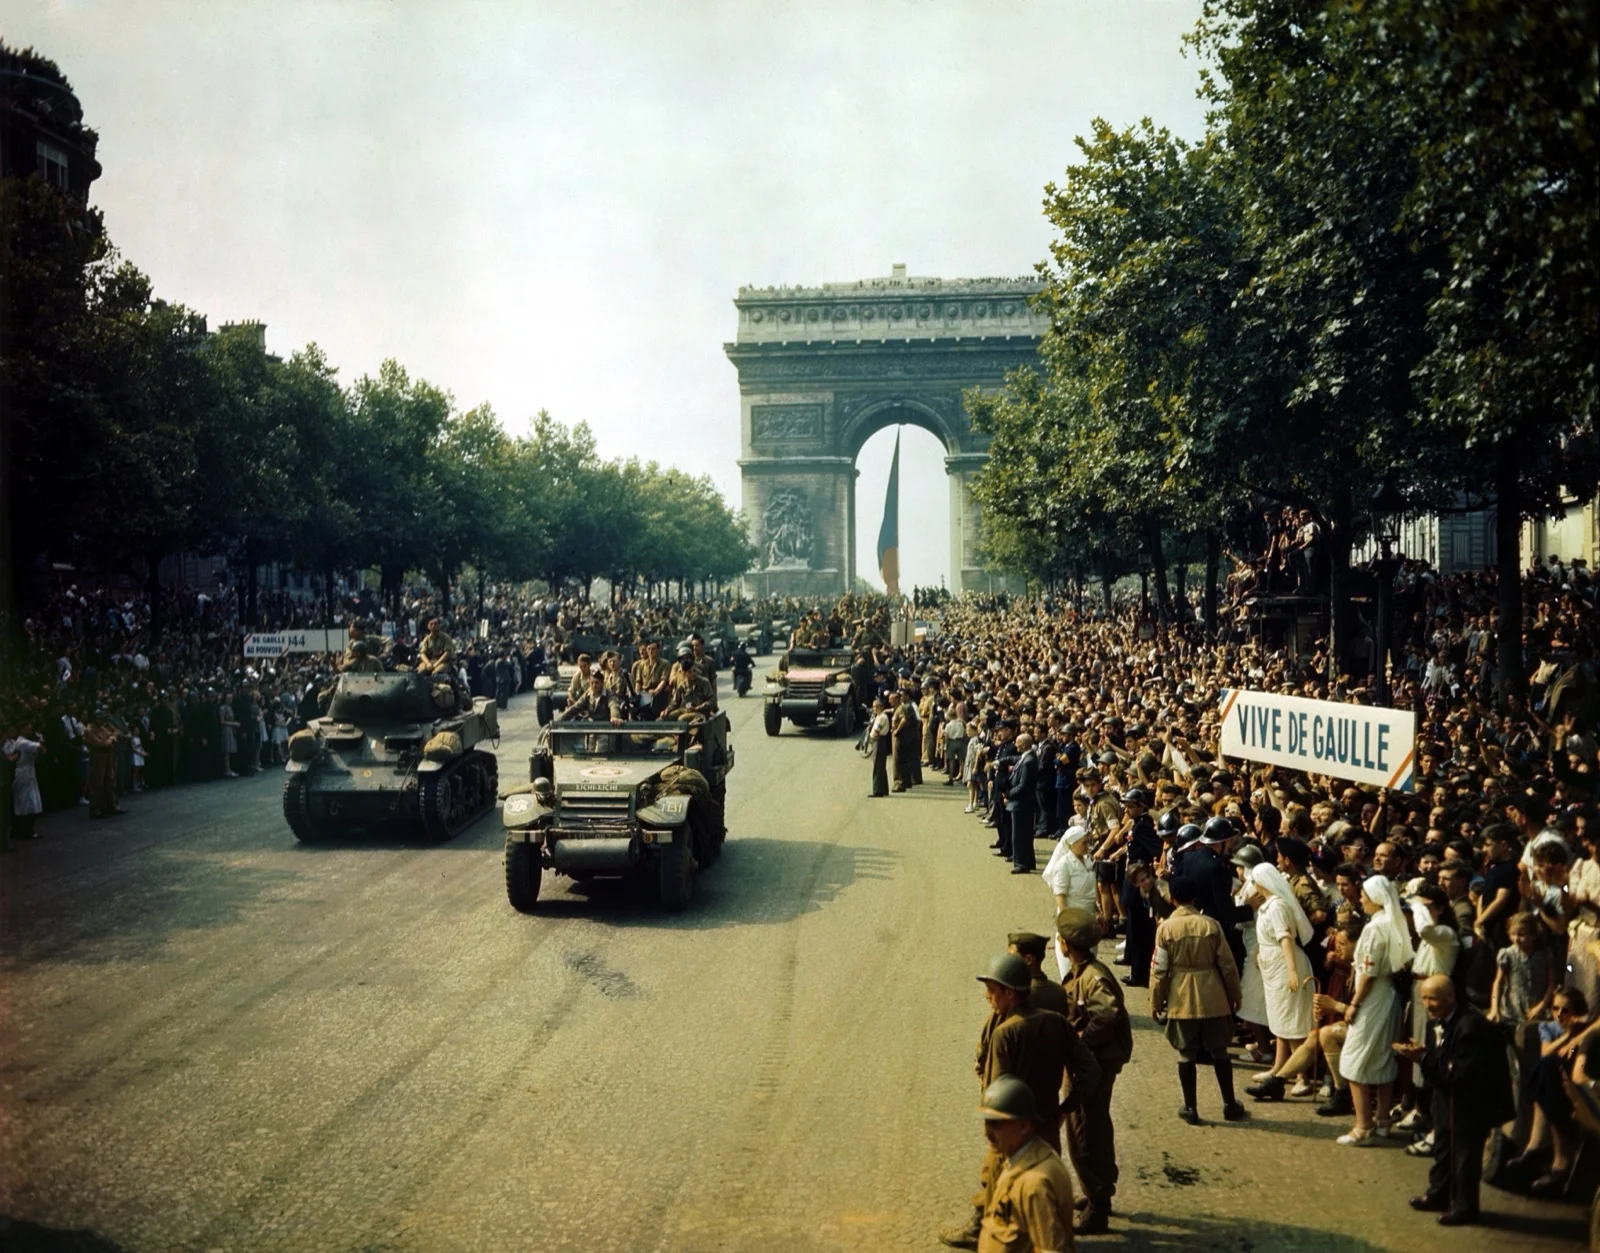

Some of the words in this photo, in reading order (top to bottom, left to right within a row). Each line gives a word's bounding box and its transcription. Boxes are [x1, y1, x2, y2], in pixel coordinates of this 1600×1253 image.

[252, 636, 260, 644] DE
[263, 636, 286, 644] GAULLE
[246, 646, 255, 654] AU
[256, 646, 283, 654] POUVOIR
[1237, 703, 1282, 752] VIVE
[1288, 711, 1308, 757] DE
[1313, 715, 1390, 772] GAULLE
